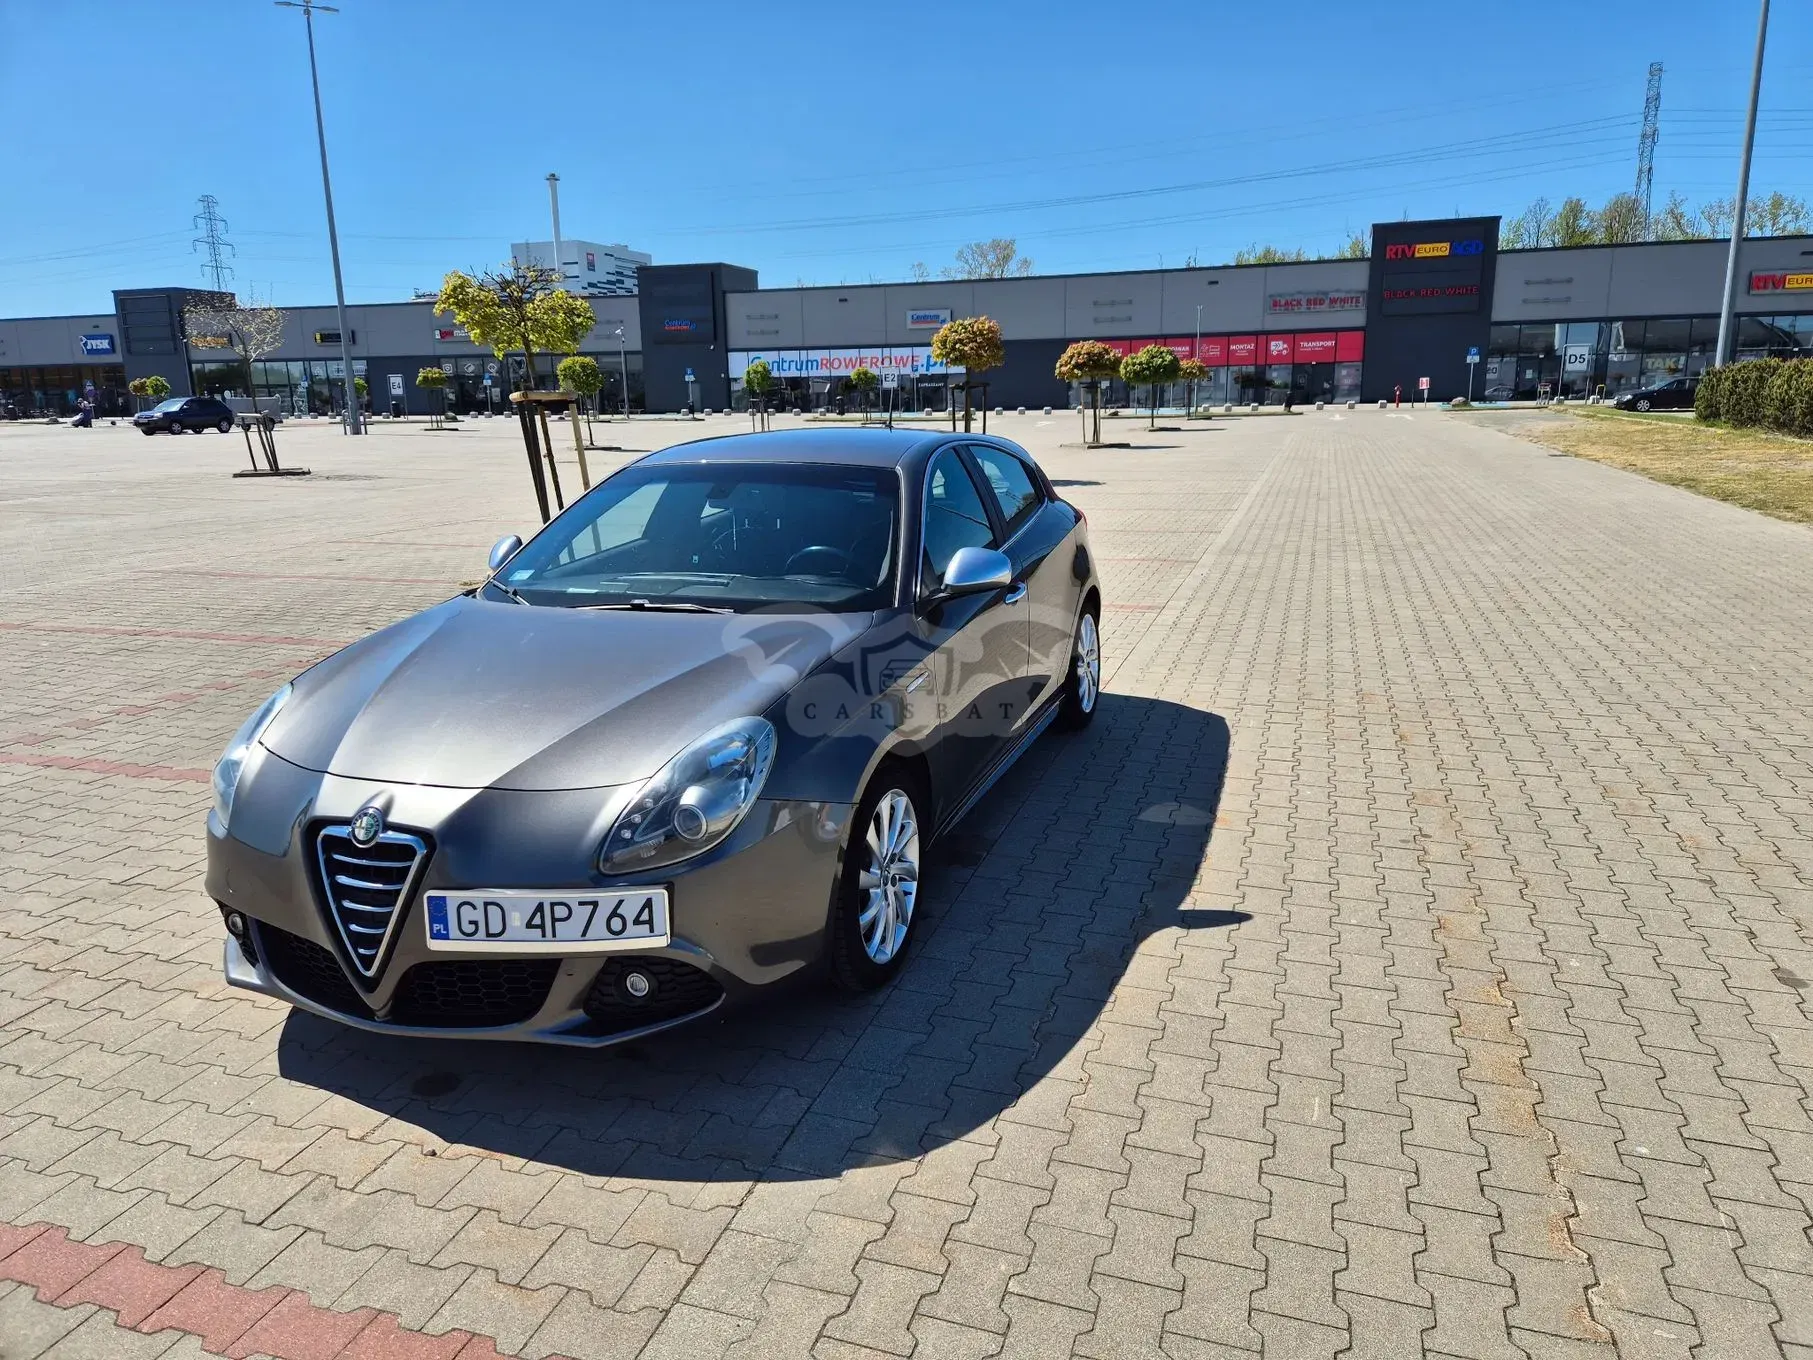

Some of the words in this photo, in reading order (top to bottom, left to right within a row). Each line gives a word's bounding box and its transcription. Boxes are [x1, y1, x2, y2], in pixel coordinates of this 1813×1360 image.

[1386, 245, 1416, 259] RTV
[1417, 245, 1448, 254] EURO
[1752, 274, 1786, 290] RTV
[1384, 290, 1416, 299] BLACK
[1420, 288, 1441, 297] RED
[1445, 286, 1479, 295] WHITE
[1271, 298, 1303, 309] BLACK
[1306, 297, 1325, 307] RED
[1328, 295, 1361, 306] WHITE
[86, 339, 111, 350] JYSK
[1568, 354, 1586, 364] D5
[884, 374, 896, 383] E2
[391, 381, 402, 390] E4
[456, 900, 508, 939] GD
[525, 897, 656, 938] 4P764
[433, 924, 447, 934] PL
